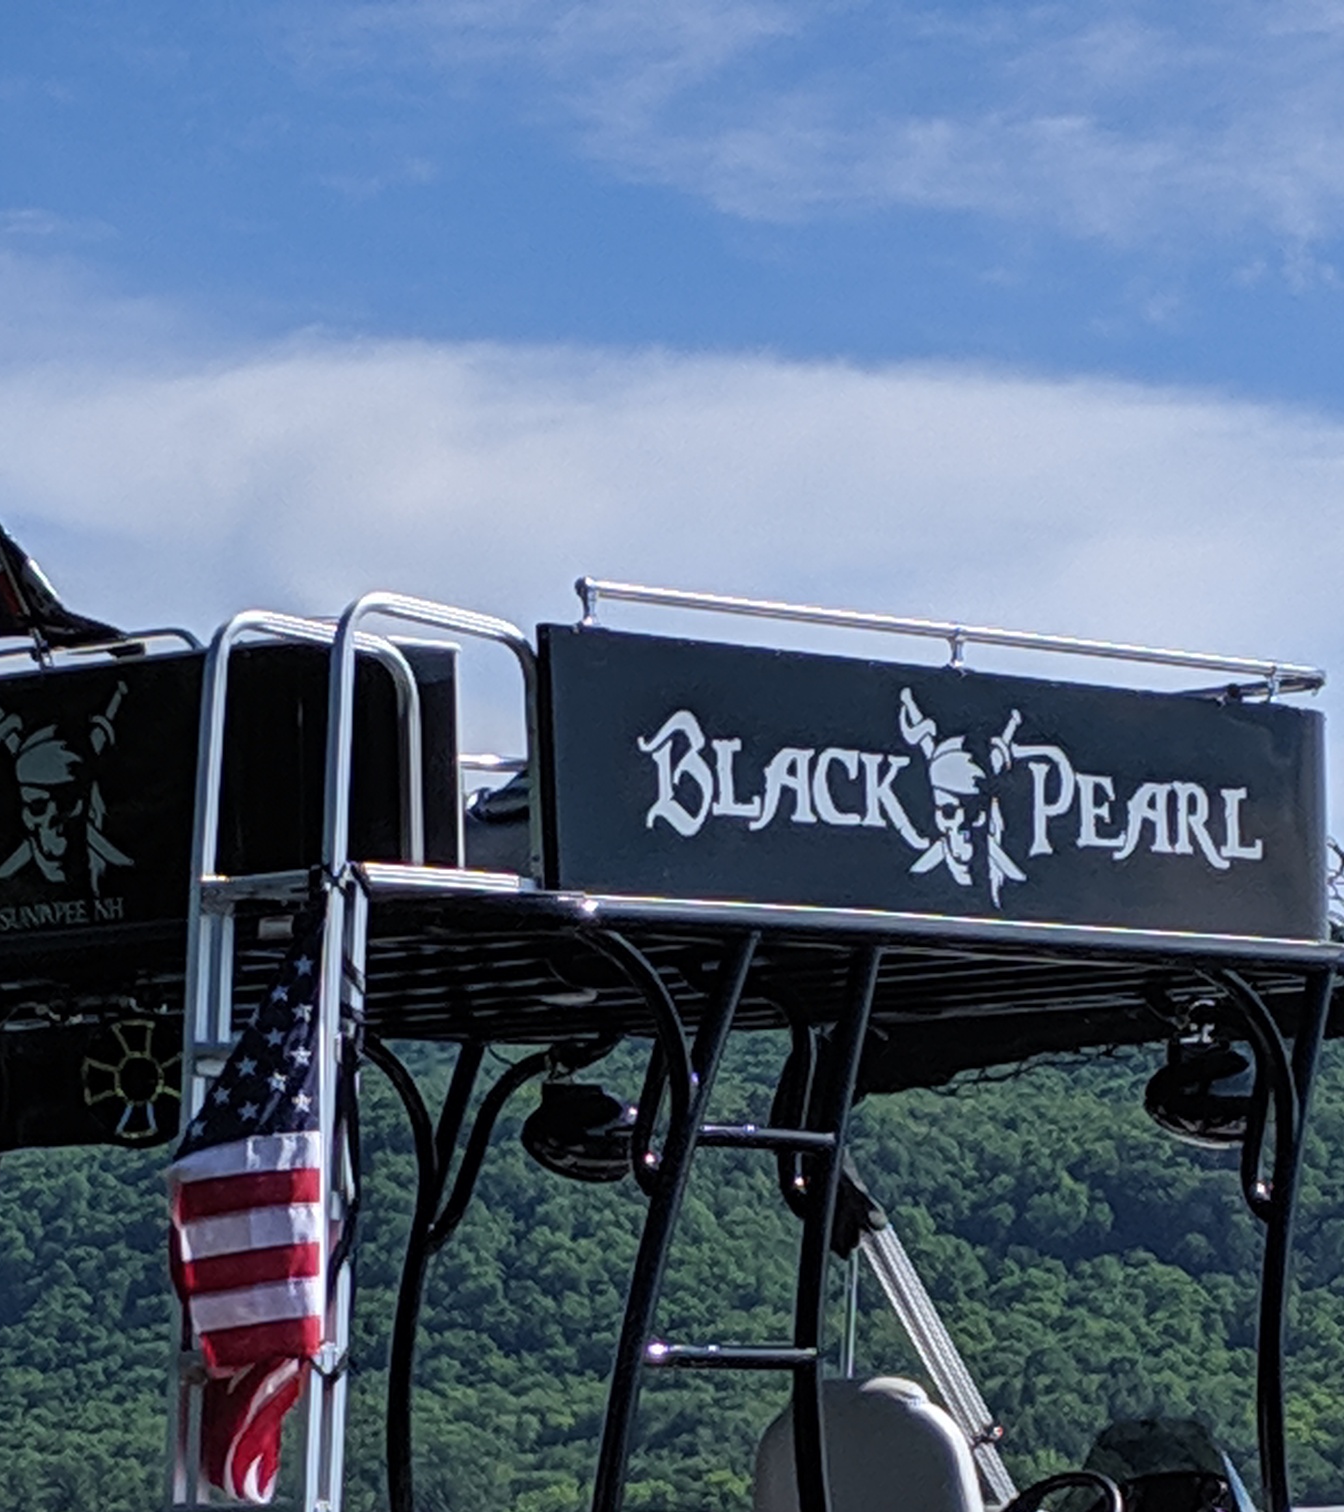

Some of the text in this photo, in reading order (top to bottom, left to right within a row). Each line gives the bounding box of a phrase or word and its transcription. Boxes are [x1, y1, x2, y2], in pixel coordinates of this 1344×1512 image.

[638, 709, 1264, 869] BLACK PEARL
[94, 897, 124, 922] NH
